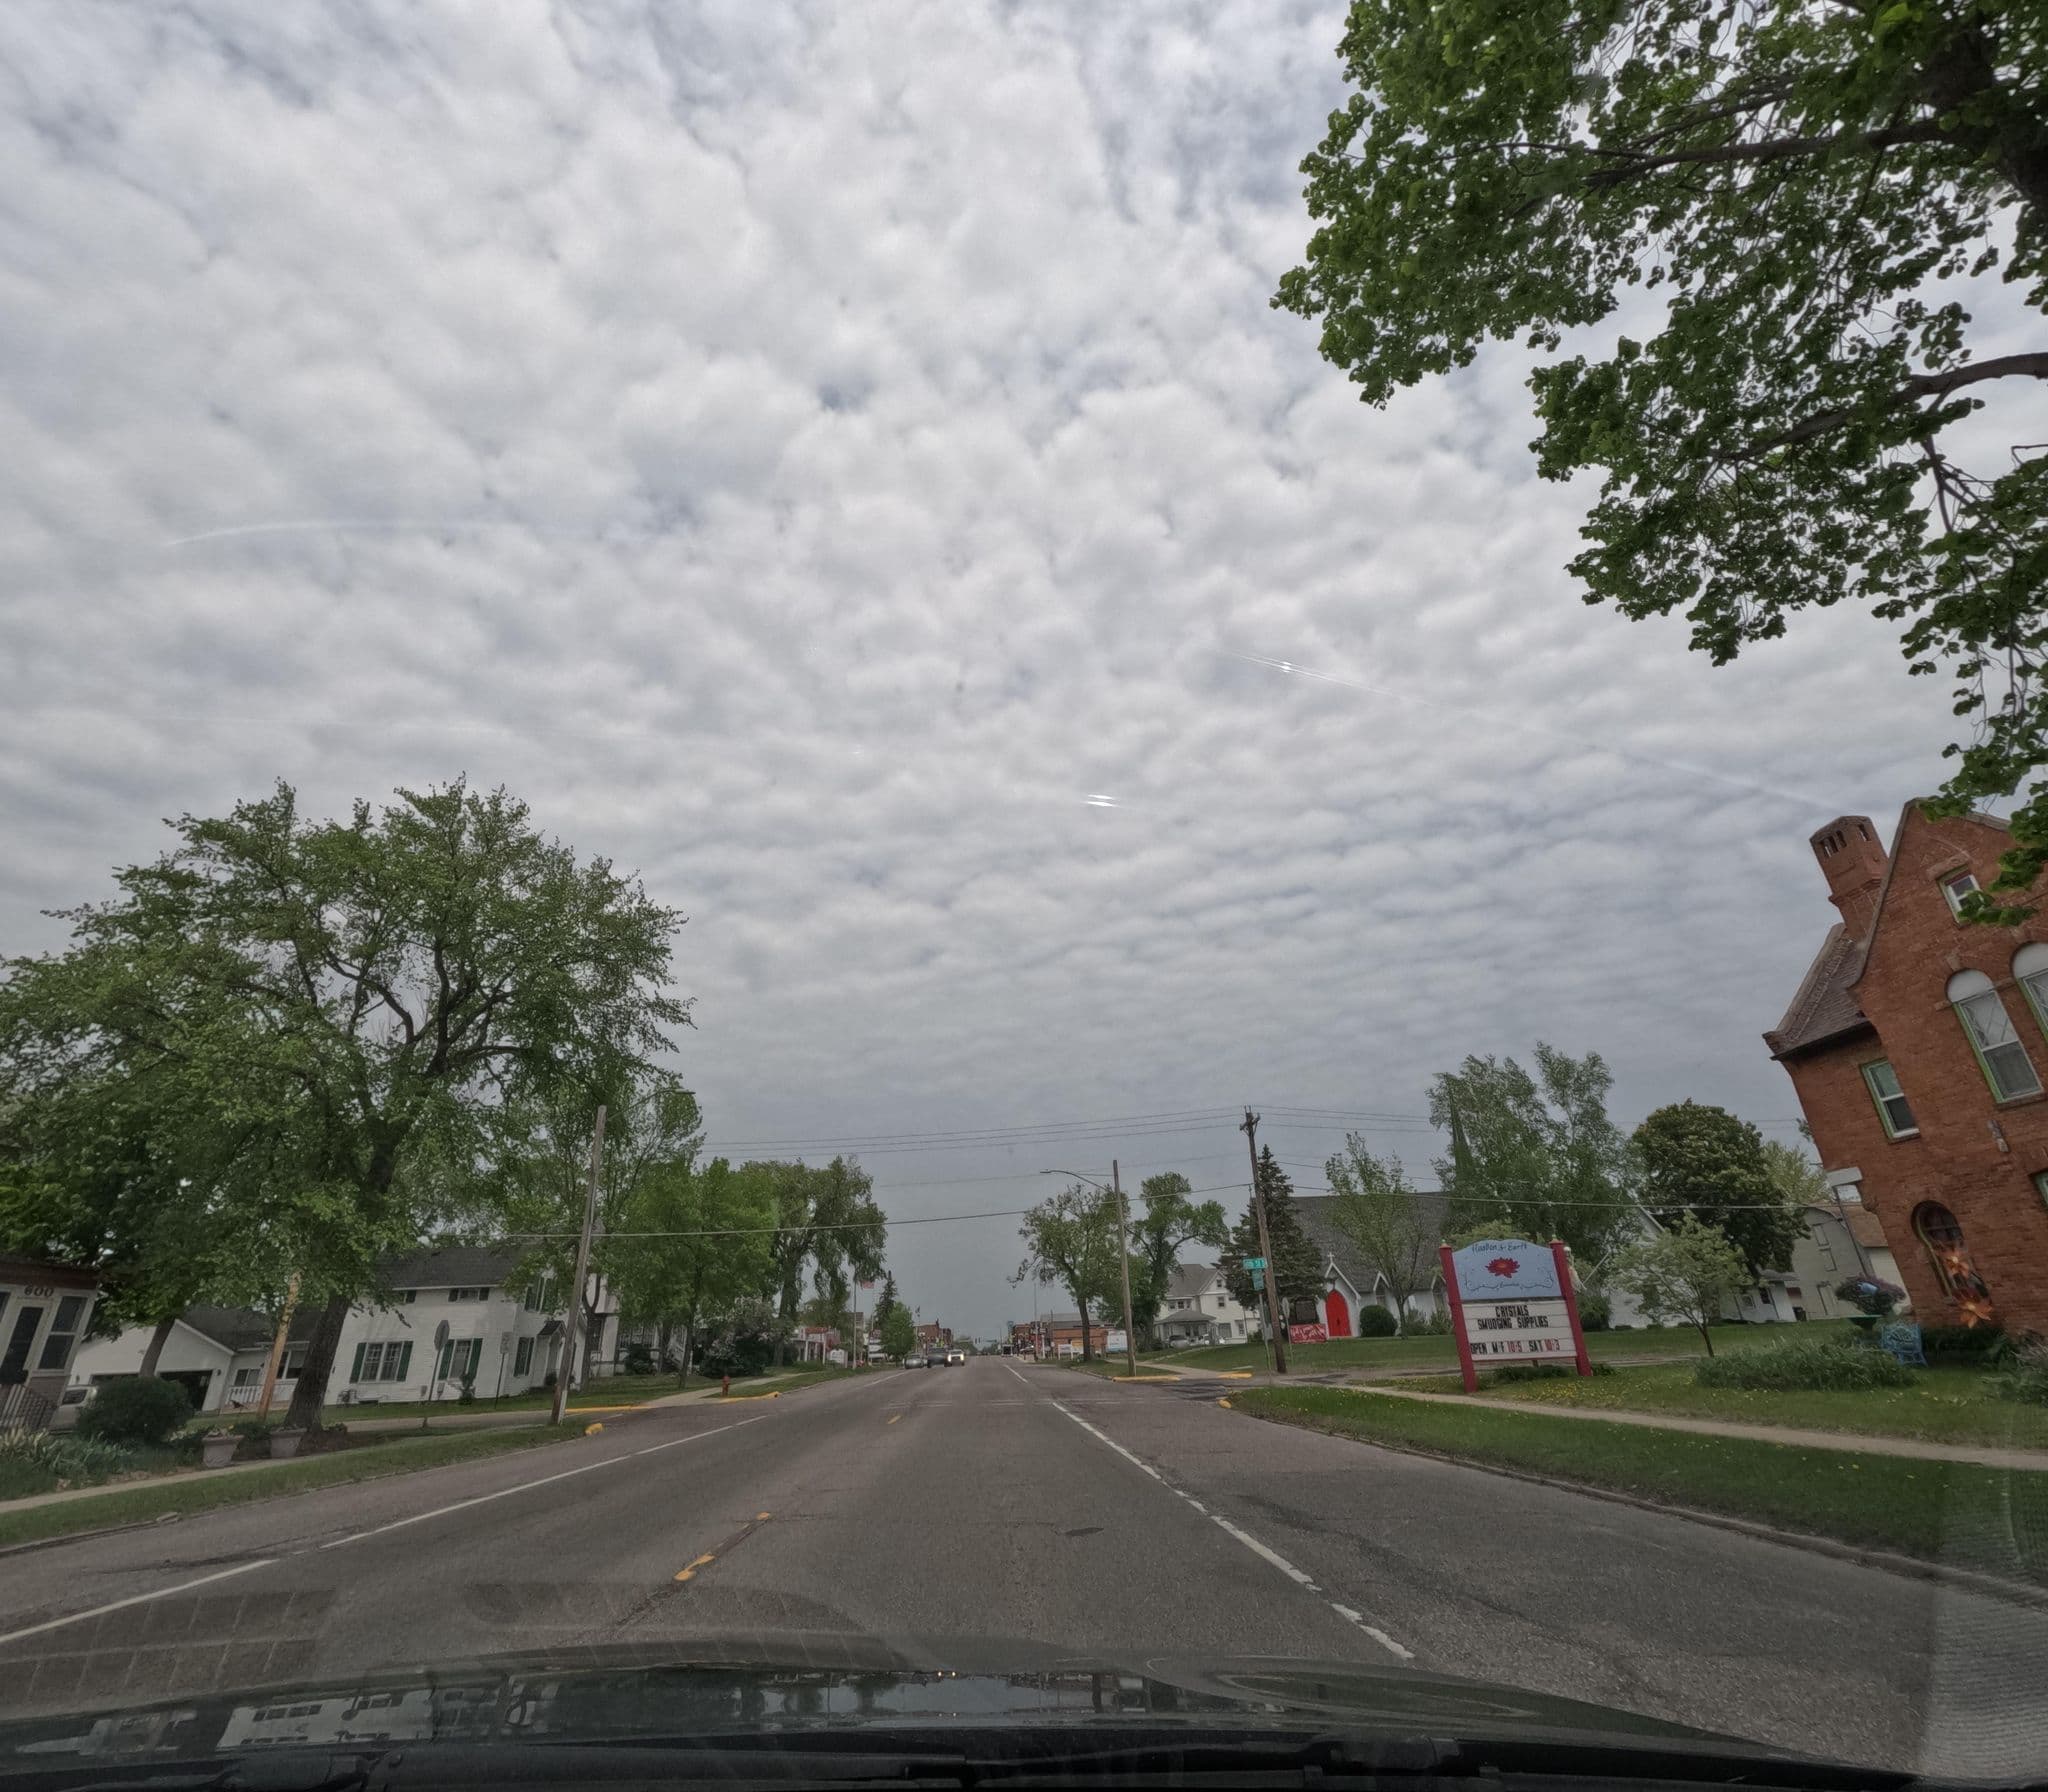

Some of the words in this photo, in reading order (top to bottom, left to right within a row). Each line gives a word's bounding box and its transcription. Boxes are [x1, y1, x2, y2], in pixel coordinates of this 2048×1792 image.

[24, 1286, 54, 1297] 600
[1495, 1305, 1529, 1317] CRYSTALS
[1477, 1317, 1512, 1330] SMUDGING
[1517, 1316, 1549, 1329] SUPPLIES
[1470, 1342, 1487, 1354] OPEN
[1528, 1340, 1543, 1352] SAT
